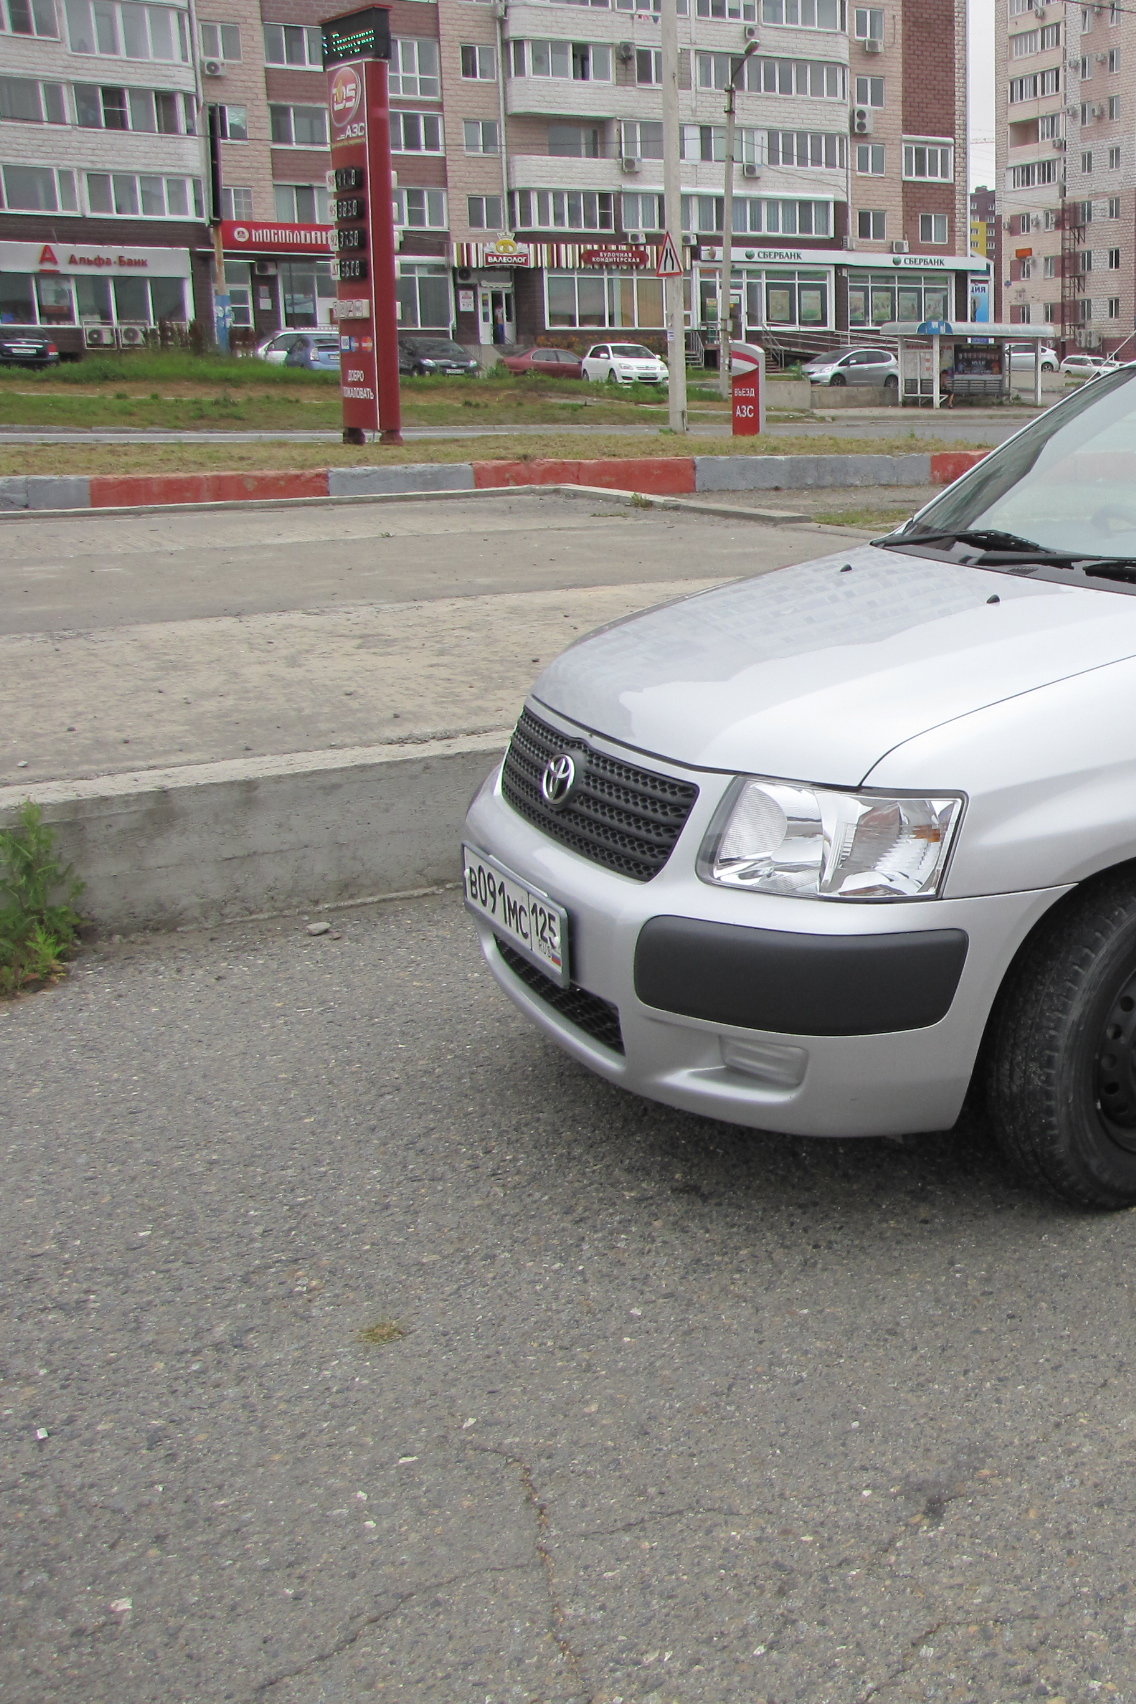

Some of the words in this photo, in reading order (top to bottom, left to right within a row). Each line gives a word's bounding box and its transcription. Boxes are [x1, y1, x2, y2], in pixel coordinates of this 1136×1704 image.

[757, 250, 802, 260] СБЕРБАНК
[903, 257, 945, 267] СБЕРБАНК
[348, 370, 364, 381] ДОБРО
[736, 405, 754, 418] АЗС
[531, 902, 557, 949] 125
